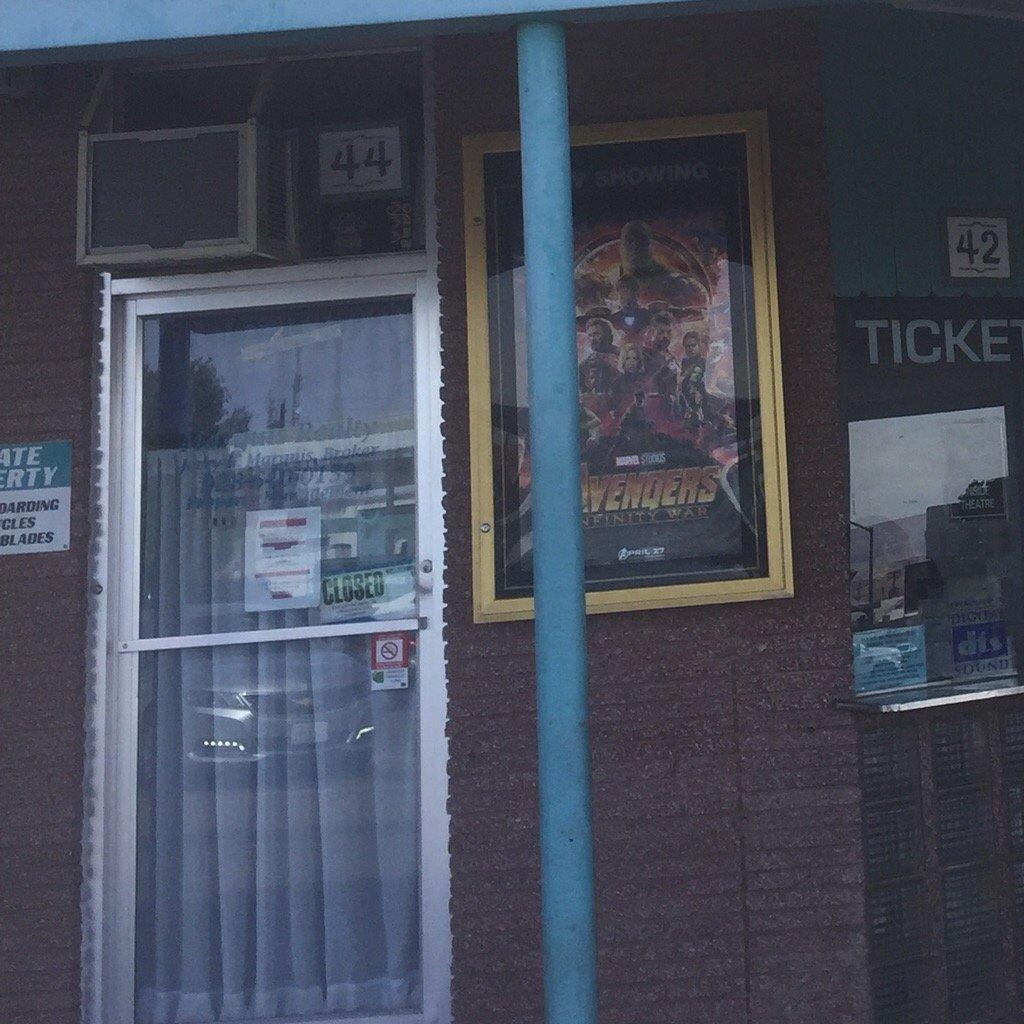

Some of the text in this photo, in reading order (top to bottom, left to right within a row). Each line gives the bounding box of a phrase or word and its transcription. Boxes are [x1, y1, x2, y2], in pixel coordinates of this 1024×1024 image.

[331, 141, 392, 179] 44
[594, 162, 710, 188] SHOWING
[956, 229, 1001, 264] 42
[961, 498, 995, 510] THEATRE
[582, 511, 658, 529] NFINITY
[0, 532, 54, 547] BLADES
[322, 570, 385, 606] CLOSED
[954, 659, 1008, 675] SOUND
